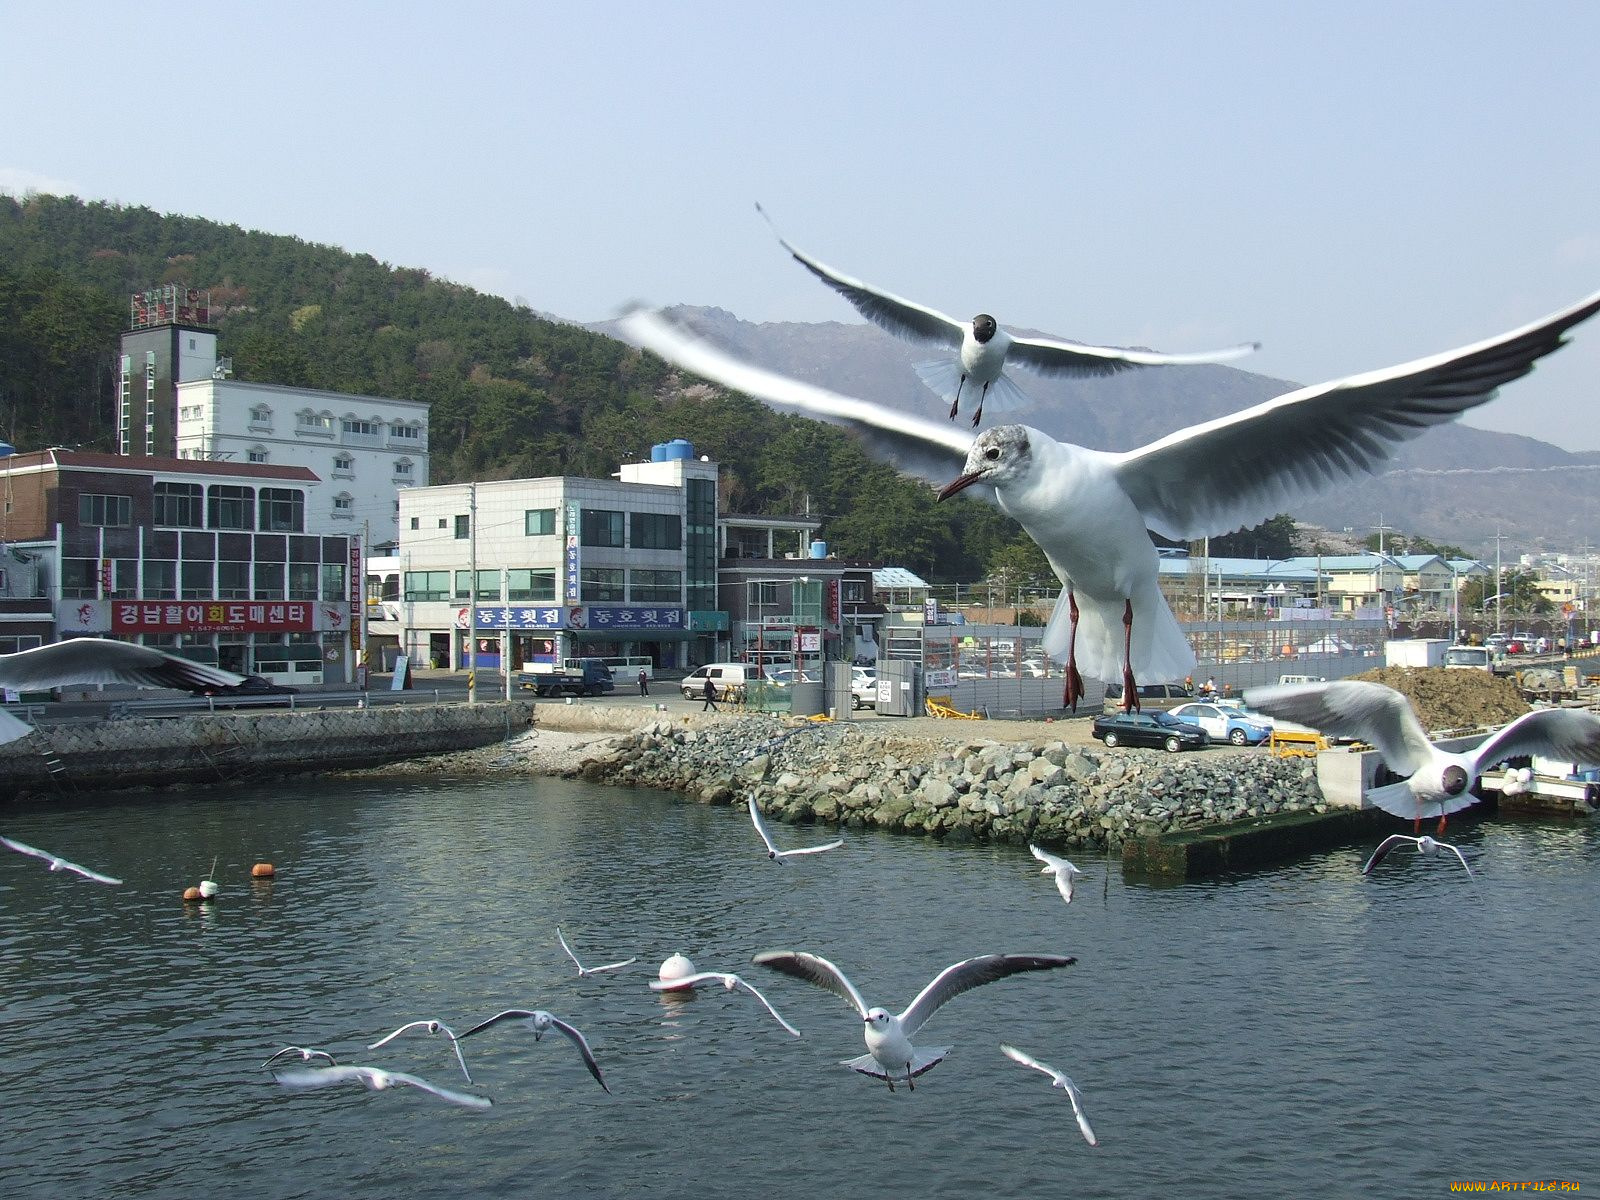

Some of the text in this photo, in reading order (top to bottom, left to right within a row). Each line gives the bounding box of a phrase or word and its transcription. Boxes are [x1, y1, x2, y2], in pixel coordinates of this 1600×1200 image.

[568, 550, 577, 597] 동호횟집
[120, 605, 306, 625] 경남활어회도매센타
[477, 609, 559, 624] 동호횟집
[593, 610, 680, 624] 동호횟집
